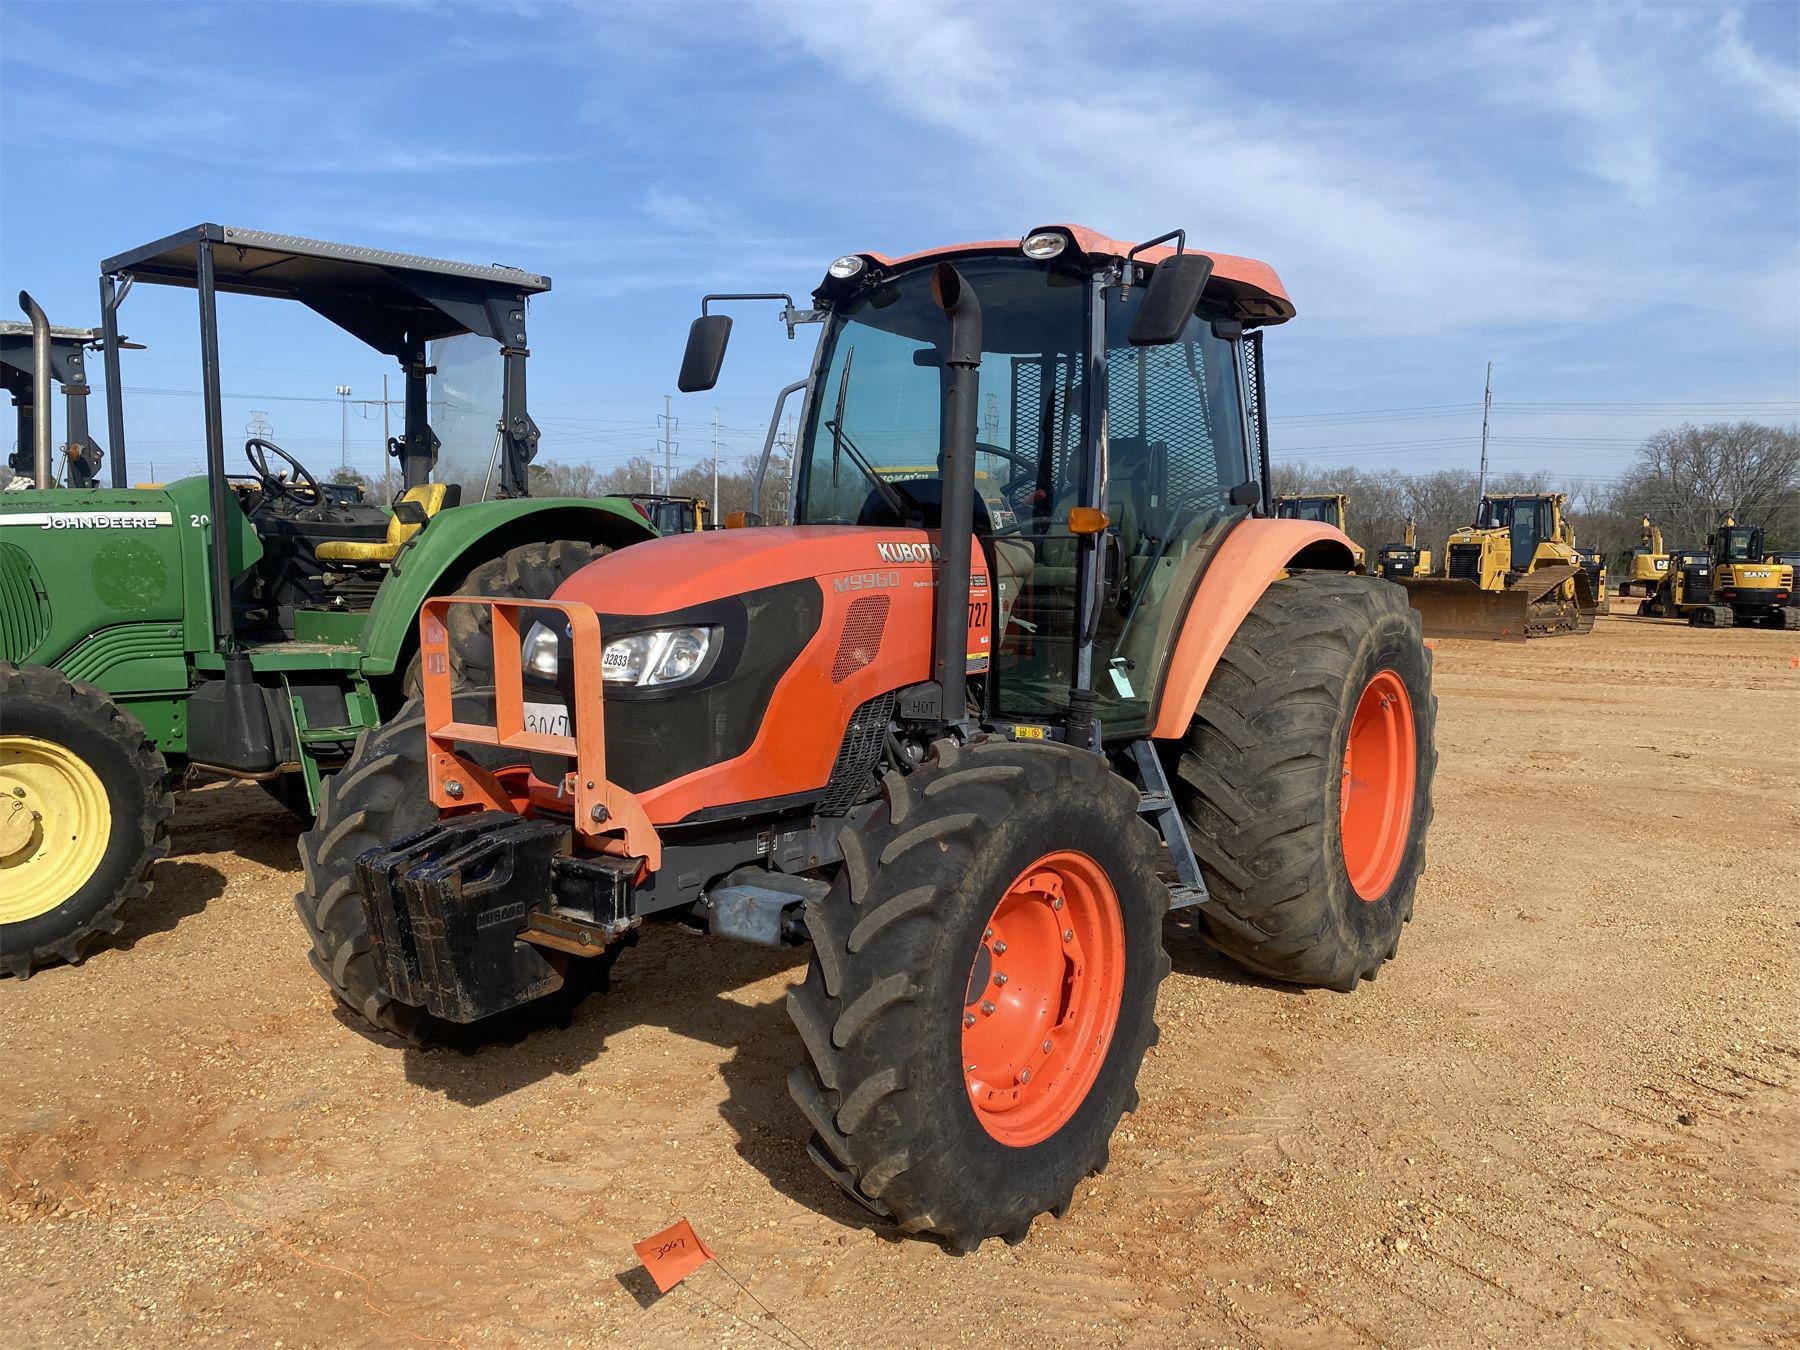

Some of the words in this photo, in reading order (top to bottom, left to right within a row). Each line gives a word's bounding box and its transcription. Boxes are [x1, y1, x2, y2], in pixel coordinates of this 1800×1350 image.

[41, 515, 93, 530] JOHN
[94, 514, 157, 529] DEERE
[876, 542, 940, 563] KUBOTA
[1656, 561, 1669, 570] CA
[834, 572, 899, 593] M9960
[603, 653, 628, 667] 32833
[912, 700, 935, 715] HOT
[650, 1238, 685, 1260] 3067
